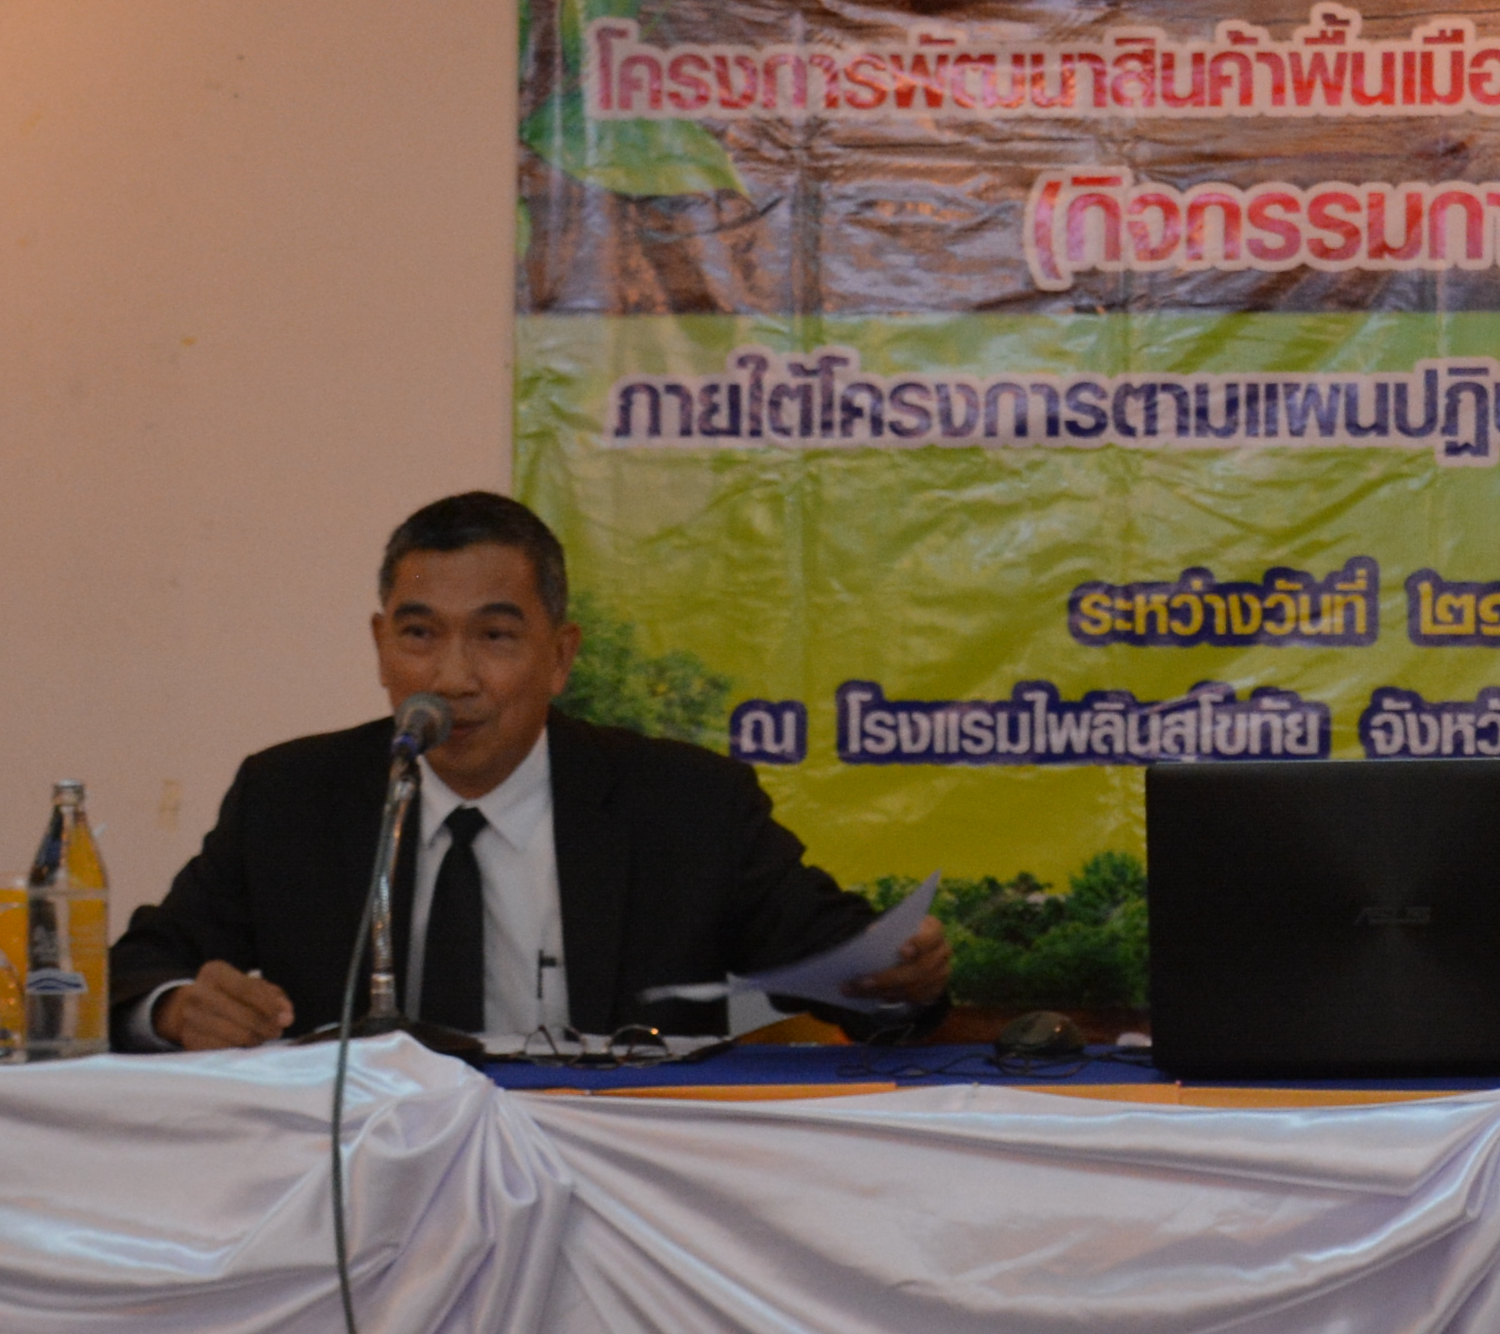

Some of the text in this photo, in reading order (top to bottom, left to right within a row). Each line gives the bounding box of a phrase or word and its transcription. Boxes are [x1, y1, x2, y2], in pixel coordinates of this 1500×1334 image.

[1078, 569, 1367, 636] ระหว่างวันที่
[740, 709, 798, 755] ณ
[846, 689, 1320, 759] โรงแรมไพลินสโขทัย
